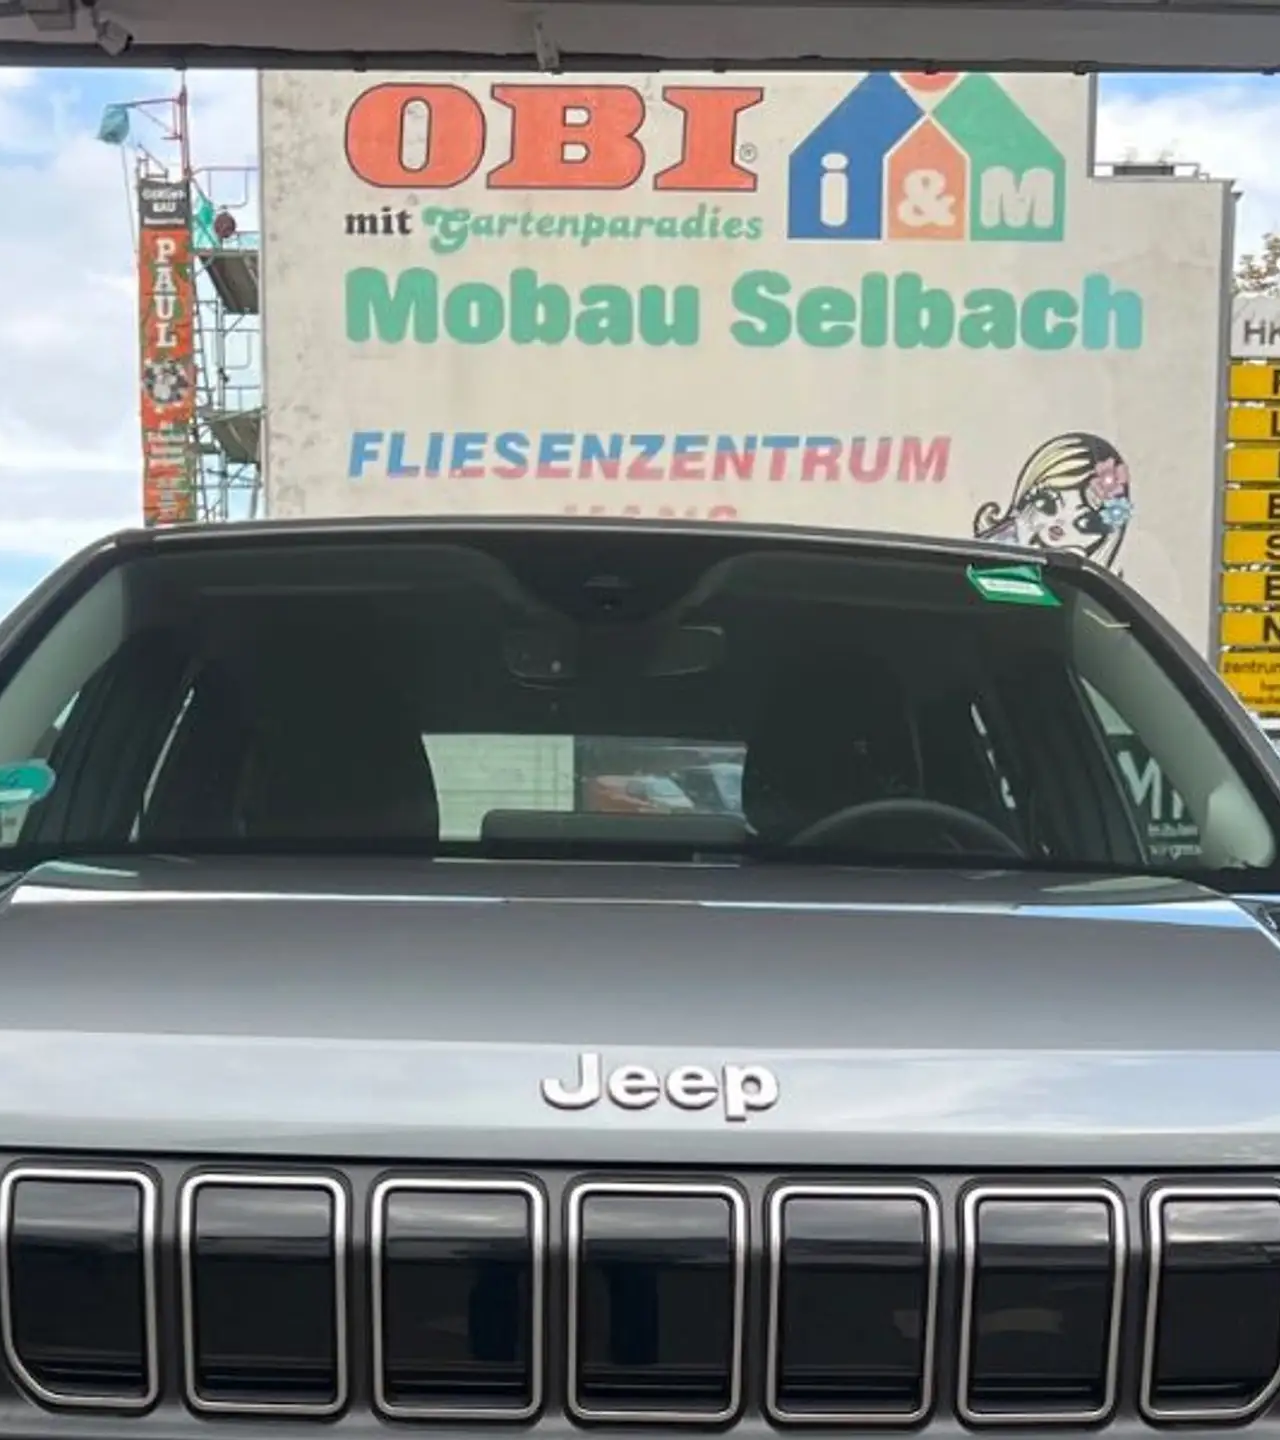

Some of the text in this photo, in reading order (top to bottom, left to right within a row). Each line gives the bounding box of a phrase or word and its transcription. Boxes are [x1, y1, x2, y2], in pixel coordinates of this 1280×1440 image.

[344, 82, 764, 190] OBI
[345, 204, 764, 254] mit Gartenparadies
[155, 238, 178, 349] PAUL
[344, 267, 1144, 350] Mobau Selbach
[348, 431, 952, 484] FLIESENZENTRUM
[541, 1053, 780, 1121] Jeep
